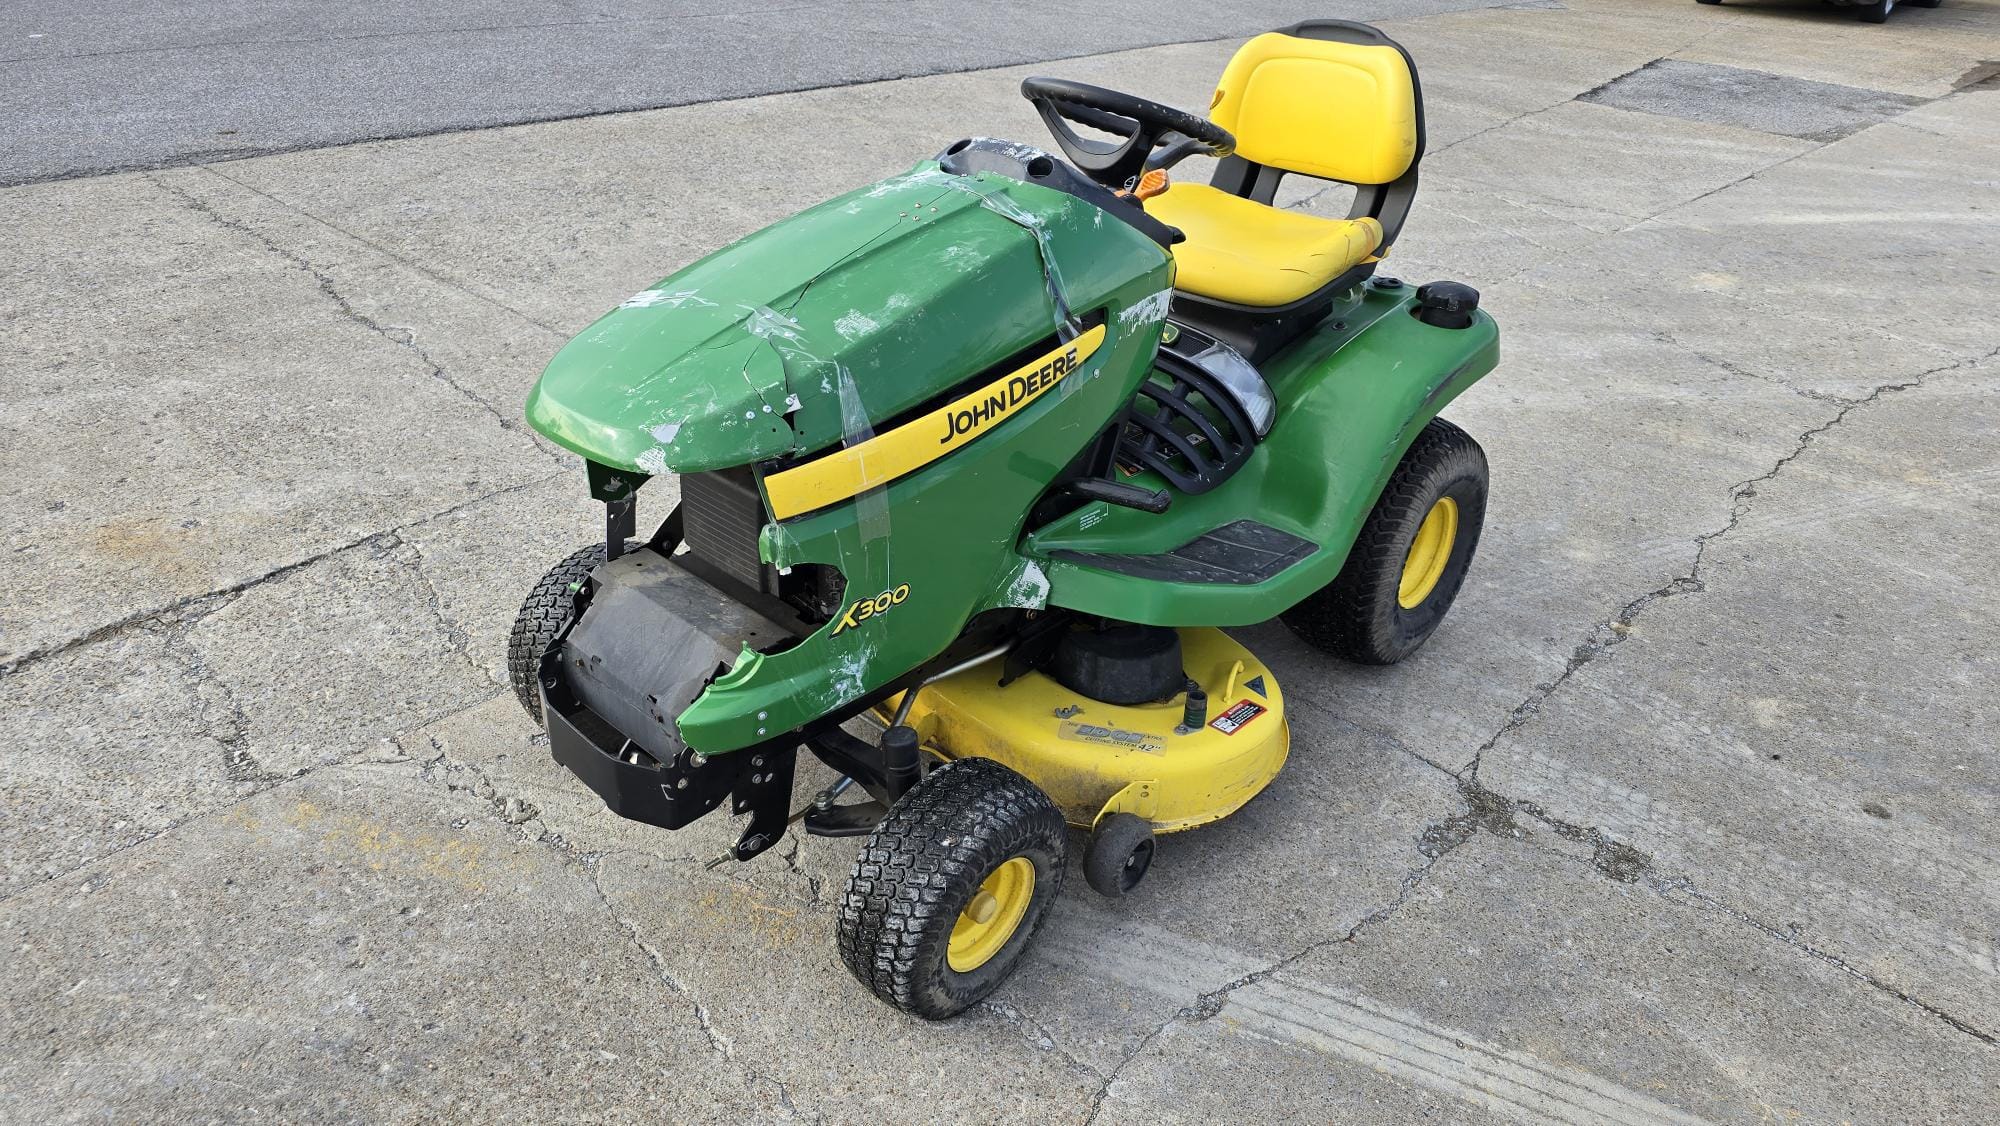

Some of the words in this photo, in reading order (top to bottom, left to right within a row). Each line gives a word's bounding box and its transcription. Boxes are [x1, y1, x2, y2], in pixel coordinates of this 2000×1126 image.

[940, 390, 1006, 445] JOHN
[1008, 347, 1077, 407] DEERE
[829, 582, 911, 640] X300
[1075, 724, 1145, 744] EDGE
[1112, 740, 1138, 748] SYSTEM
